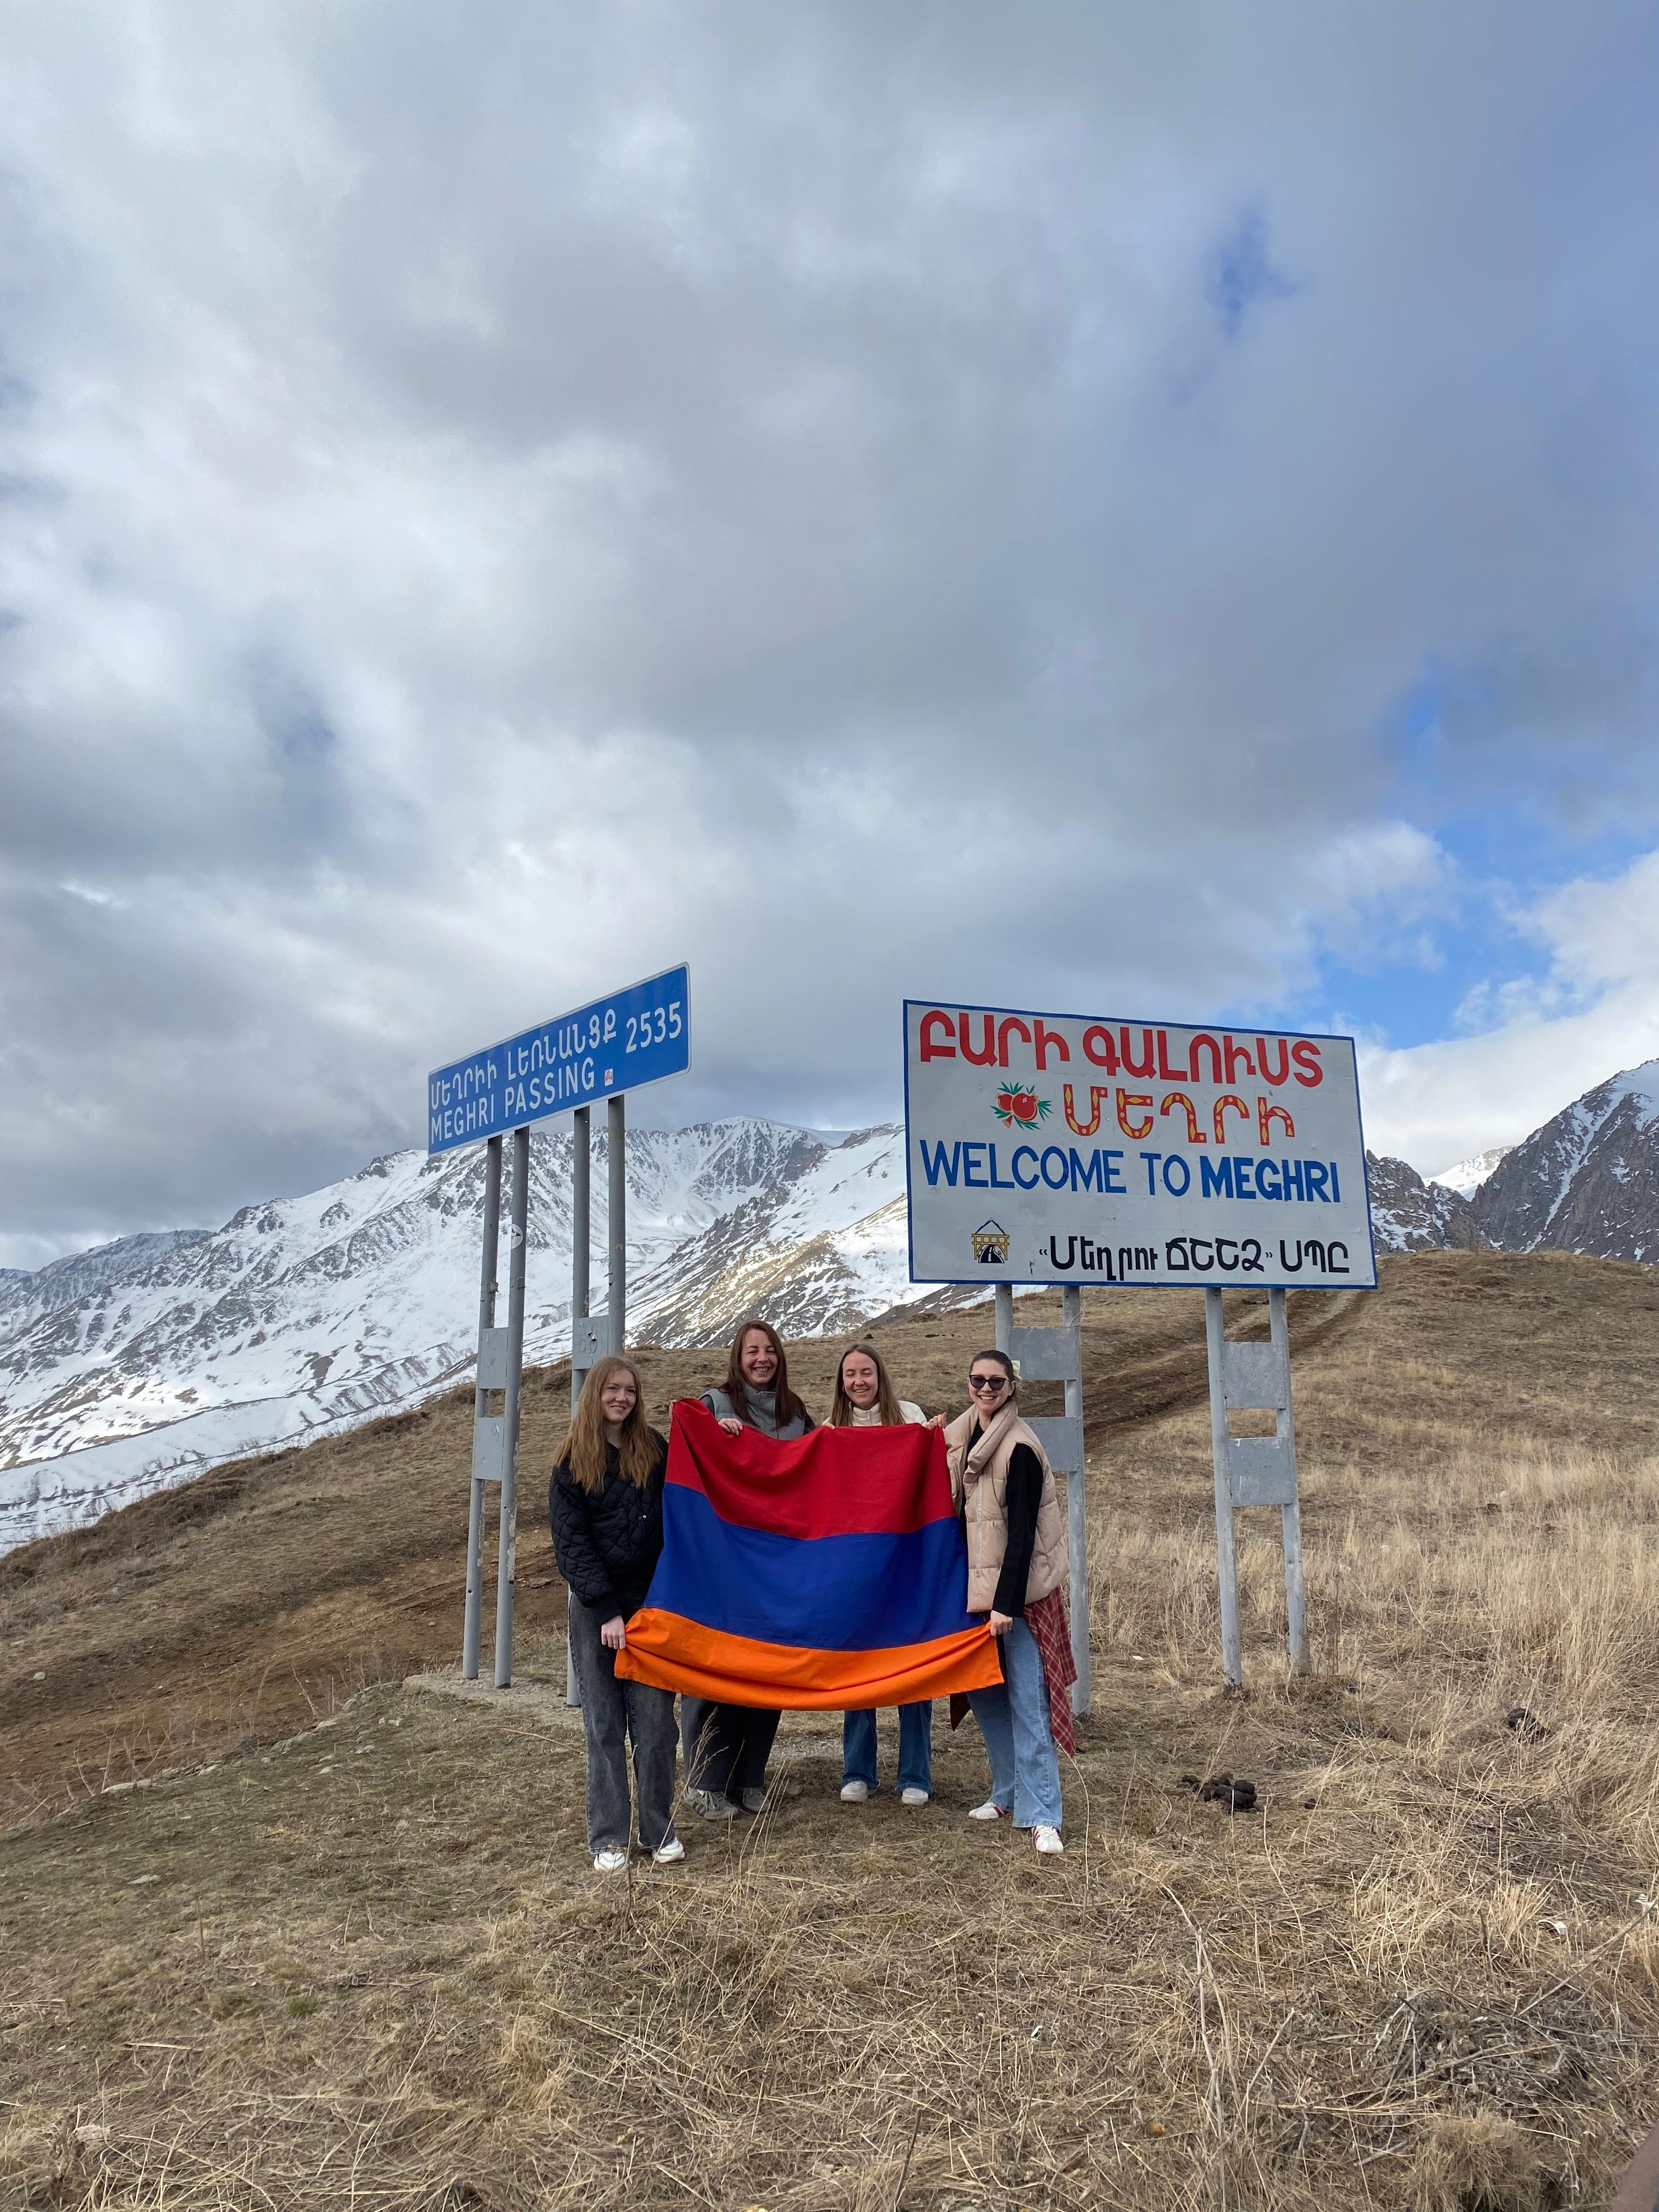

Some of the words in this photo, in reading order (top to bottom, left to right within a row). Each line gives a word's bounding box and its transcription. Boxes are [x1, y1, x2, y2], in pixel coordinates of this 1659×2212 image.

[431, 1059, 497, 1110] ՄԵՂՐԻԻ
[507, 1009, 617, 1081] ԼԵՌՆԱՆՑՔ
[625, 1001, 682, 1053] 2535
[920, 1010, 1070, 1070] ԲԱՐԻ
[1082, 1025, 1323, 1088] ԳԱԼՈՒՍՏ
[431, 1093, 494, 1144] MEGHRI
[505, 1057, 595, 1118] PASSING
[1063, 1084, 1295, 1146] ՄԵՂՐԻ
[919, 1139, 1127, 1193] WELCOME
[1140, 1152, 1190, 1197] TO
[1200, 1155, 1341, 1203] MEGHRI
[1279, 1239, 1350, 1273] ՍՊԸ
